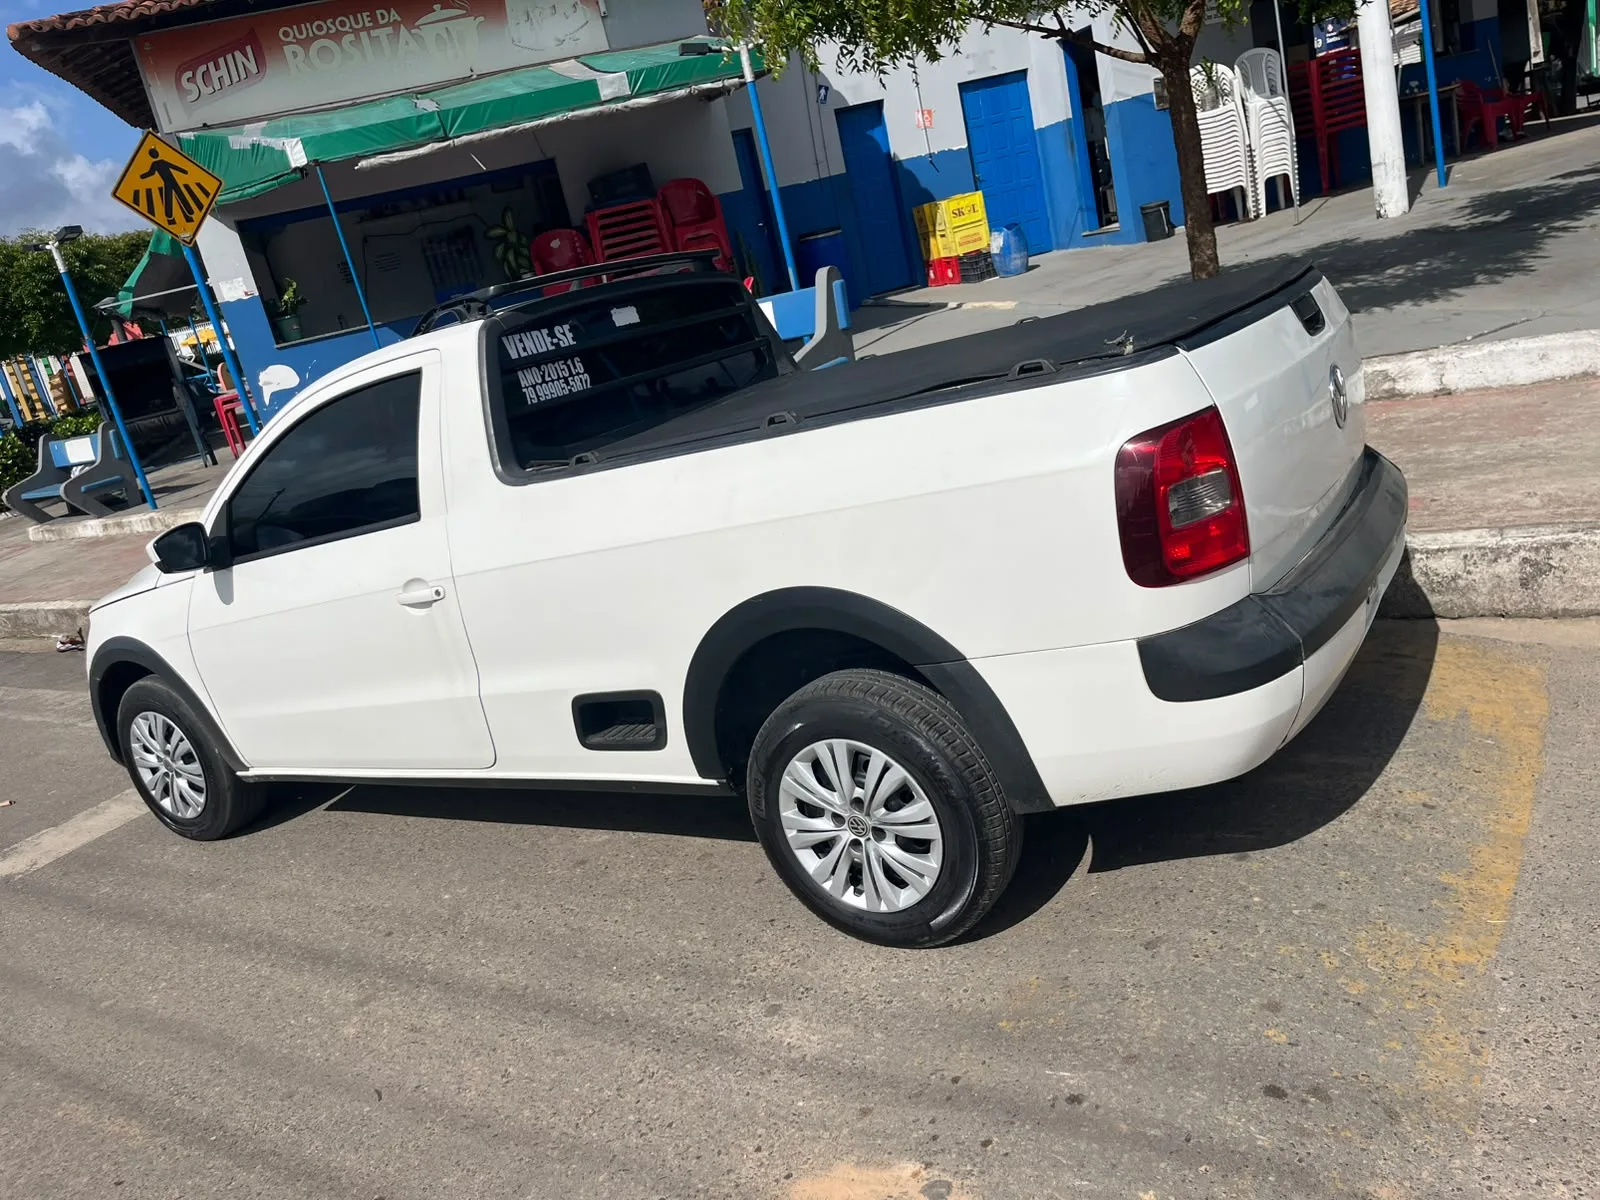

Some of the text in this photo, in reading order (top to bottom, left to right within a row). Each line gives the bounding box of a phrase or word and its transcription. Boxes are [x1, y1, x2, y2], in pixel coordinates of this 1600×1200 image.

[279, 8, 401, 42] QUIOSQUE DA
[283, 24, 423, 77] ROSITA
[181, 45, 259, 103] SCHIN
[501, 324, 576, 359] VENDE-SE
[522, 387, 538, 405] 79
